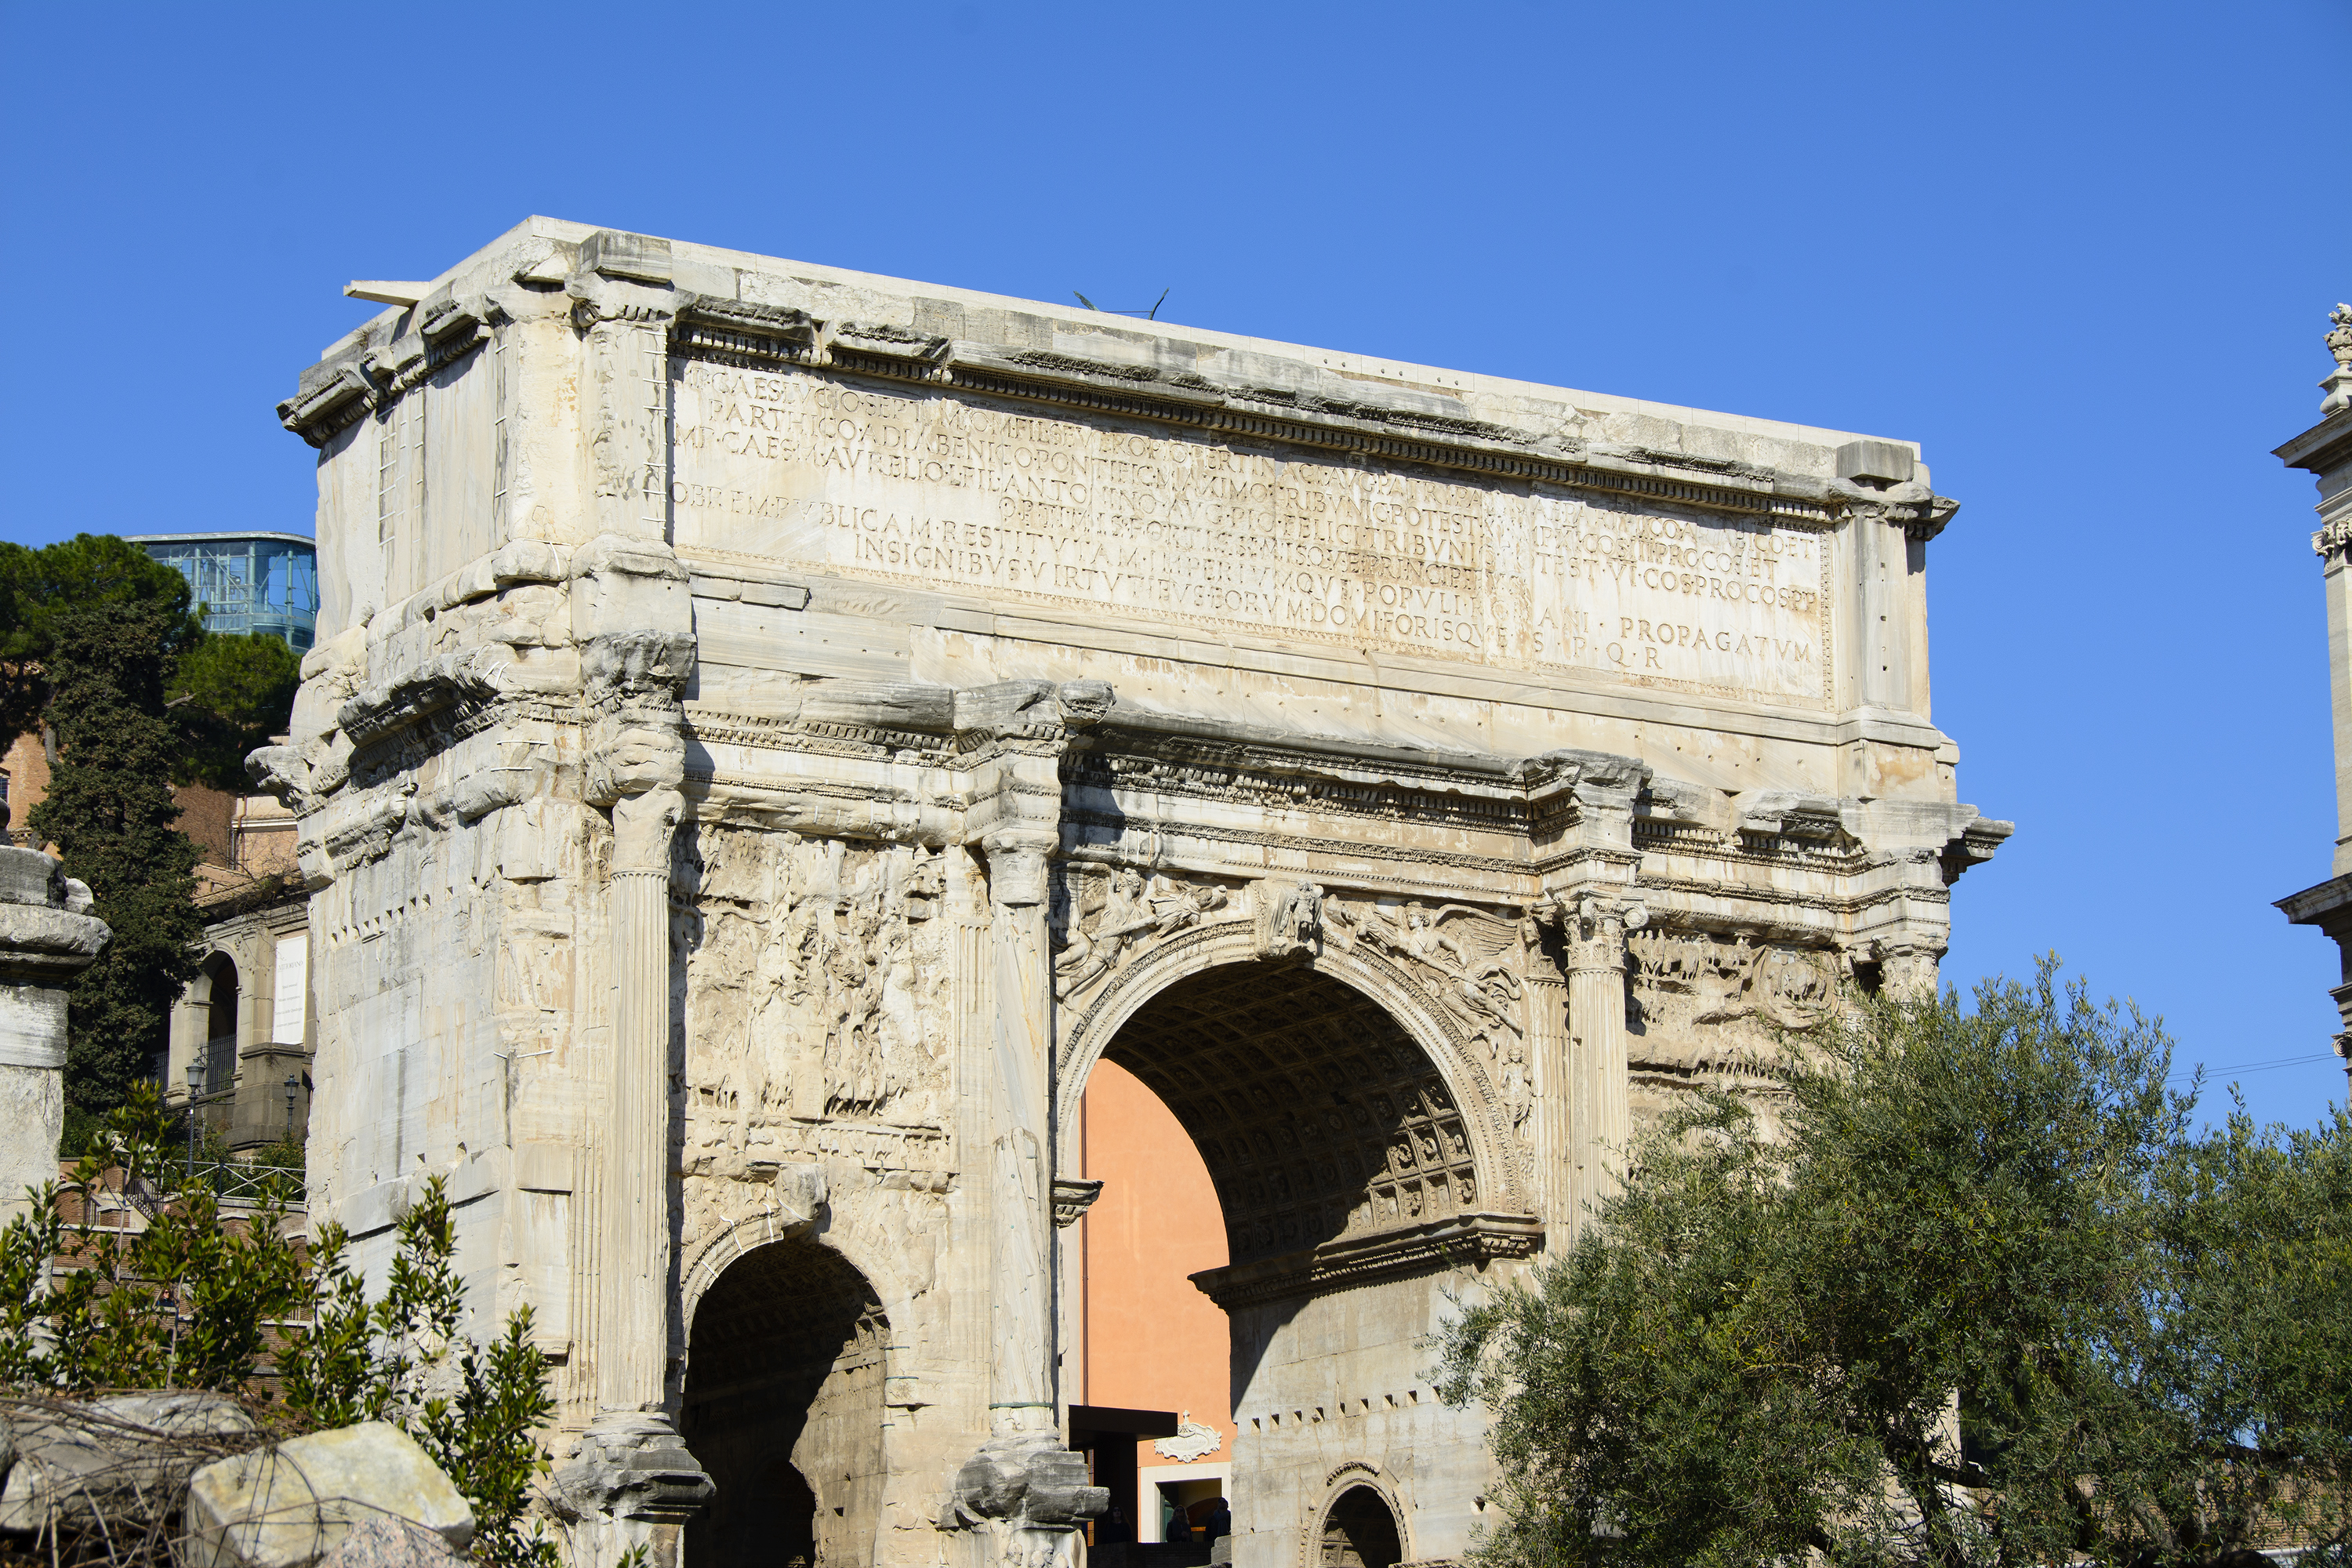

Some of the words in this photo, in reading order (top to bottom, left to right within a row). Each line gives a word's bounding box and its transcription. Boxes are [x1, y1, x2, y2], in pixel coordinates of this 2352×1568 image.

[673, 422, 715, 449] MP
[721, 430, 794, 462] CAES
[821, 445, 944, 483] AVRELIO
[1232, 506, 1275, 533] PIO
[1642, 568, 1693, 594] COS
[1693, 575, 1789, 608] PROCOS
[709, 398, 856, 441] PARTHICO
[858, 423, 1033, 469] ADIABENICO
[1390, 503, 1479, 538] POTEST
[1749, 557, 1779, 580] ET
[711, 372, 782, 403] CAES
[1324, 466, 1376, 492] AVG
[1787, 535, 1815, 560] ET
[775, 495, 934, 541] PVBLICAM
[1362, 579, 1462, 616] POPVLI
[1619, 616, 1811, 663] PROPAGATVM
[855, 533, 1021, 582] INSIGNIBVS
[1309, 601, 1380, 633] DOMI
